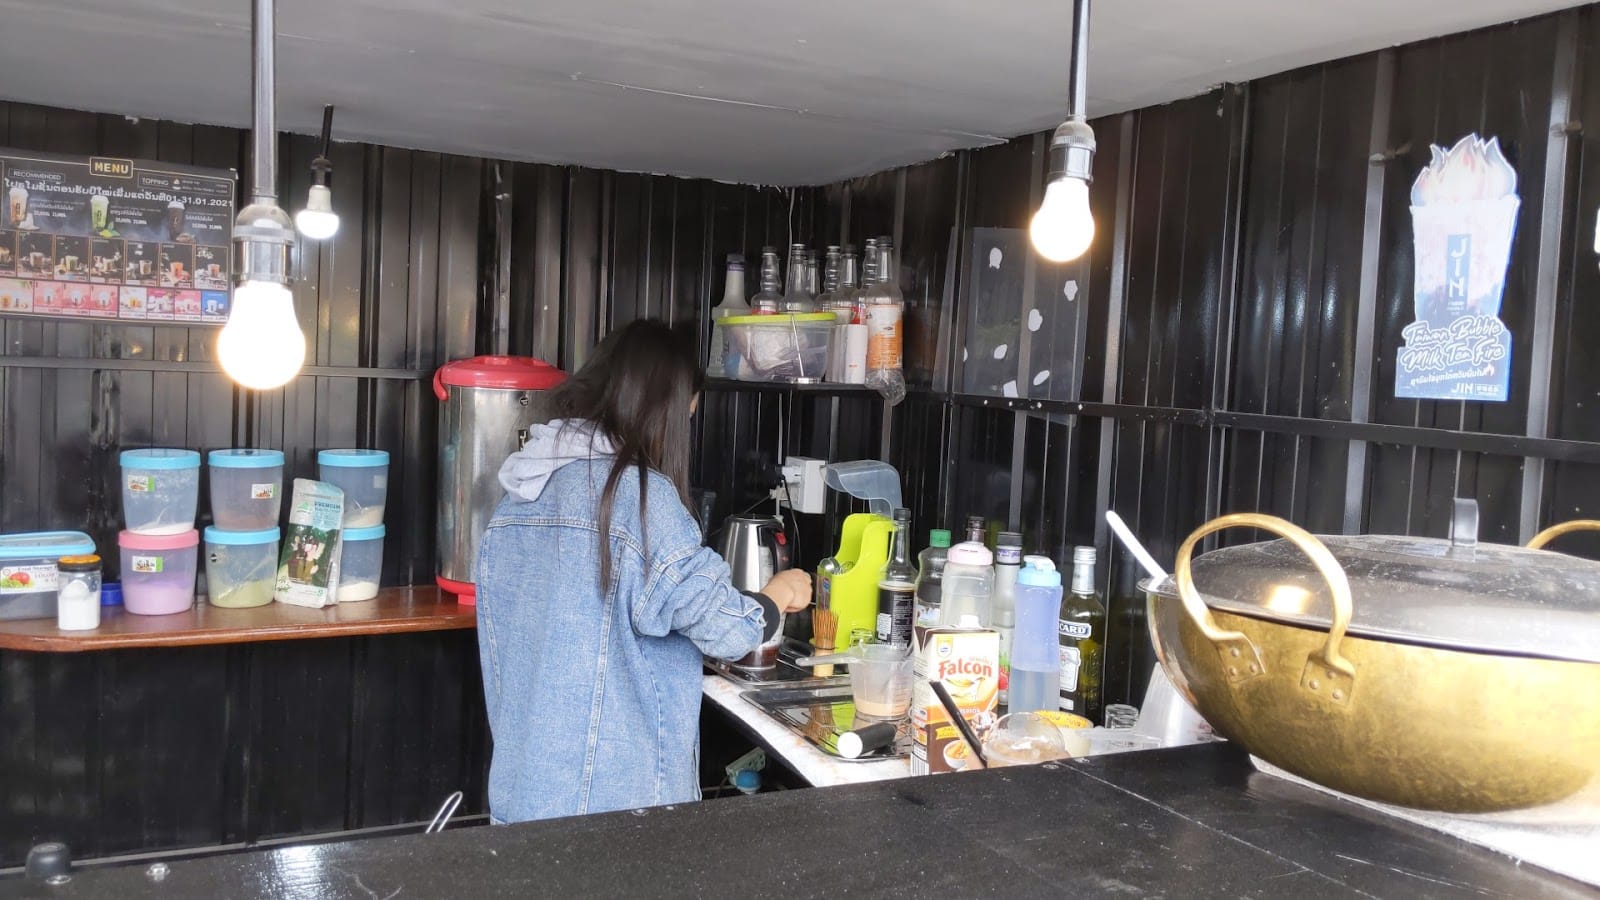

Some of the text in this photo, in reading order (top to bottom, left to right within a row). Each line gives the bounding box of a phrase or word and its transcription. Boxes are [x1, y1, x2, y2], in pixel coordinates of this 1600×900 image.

[94, 162, 129, 174] MENU
[13, 170, 62, 180] RECOMMENDED
[142, 177, 169, 186] TOPPING
[1451, 318, 1501, 340] Bubble
[1401, 347, 1442, 370] Milk
[1473, 338, 1502, 364] Fire
[1451, 384, 1473, 393] JIN
[1059, 623, 1088, 634] CARD
[938, 658, 993, 679] Falcon
